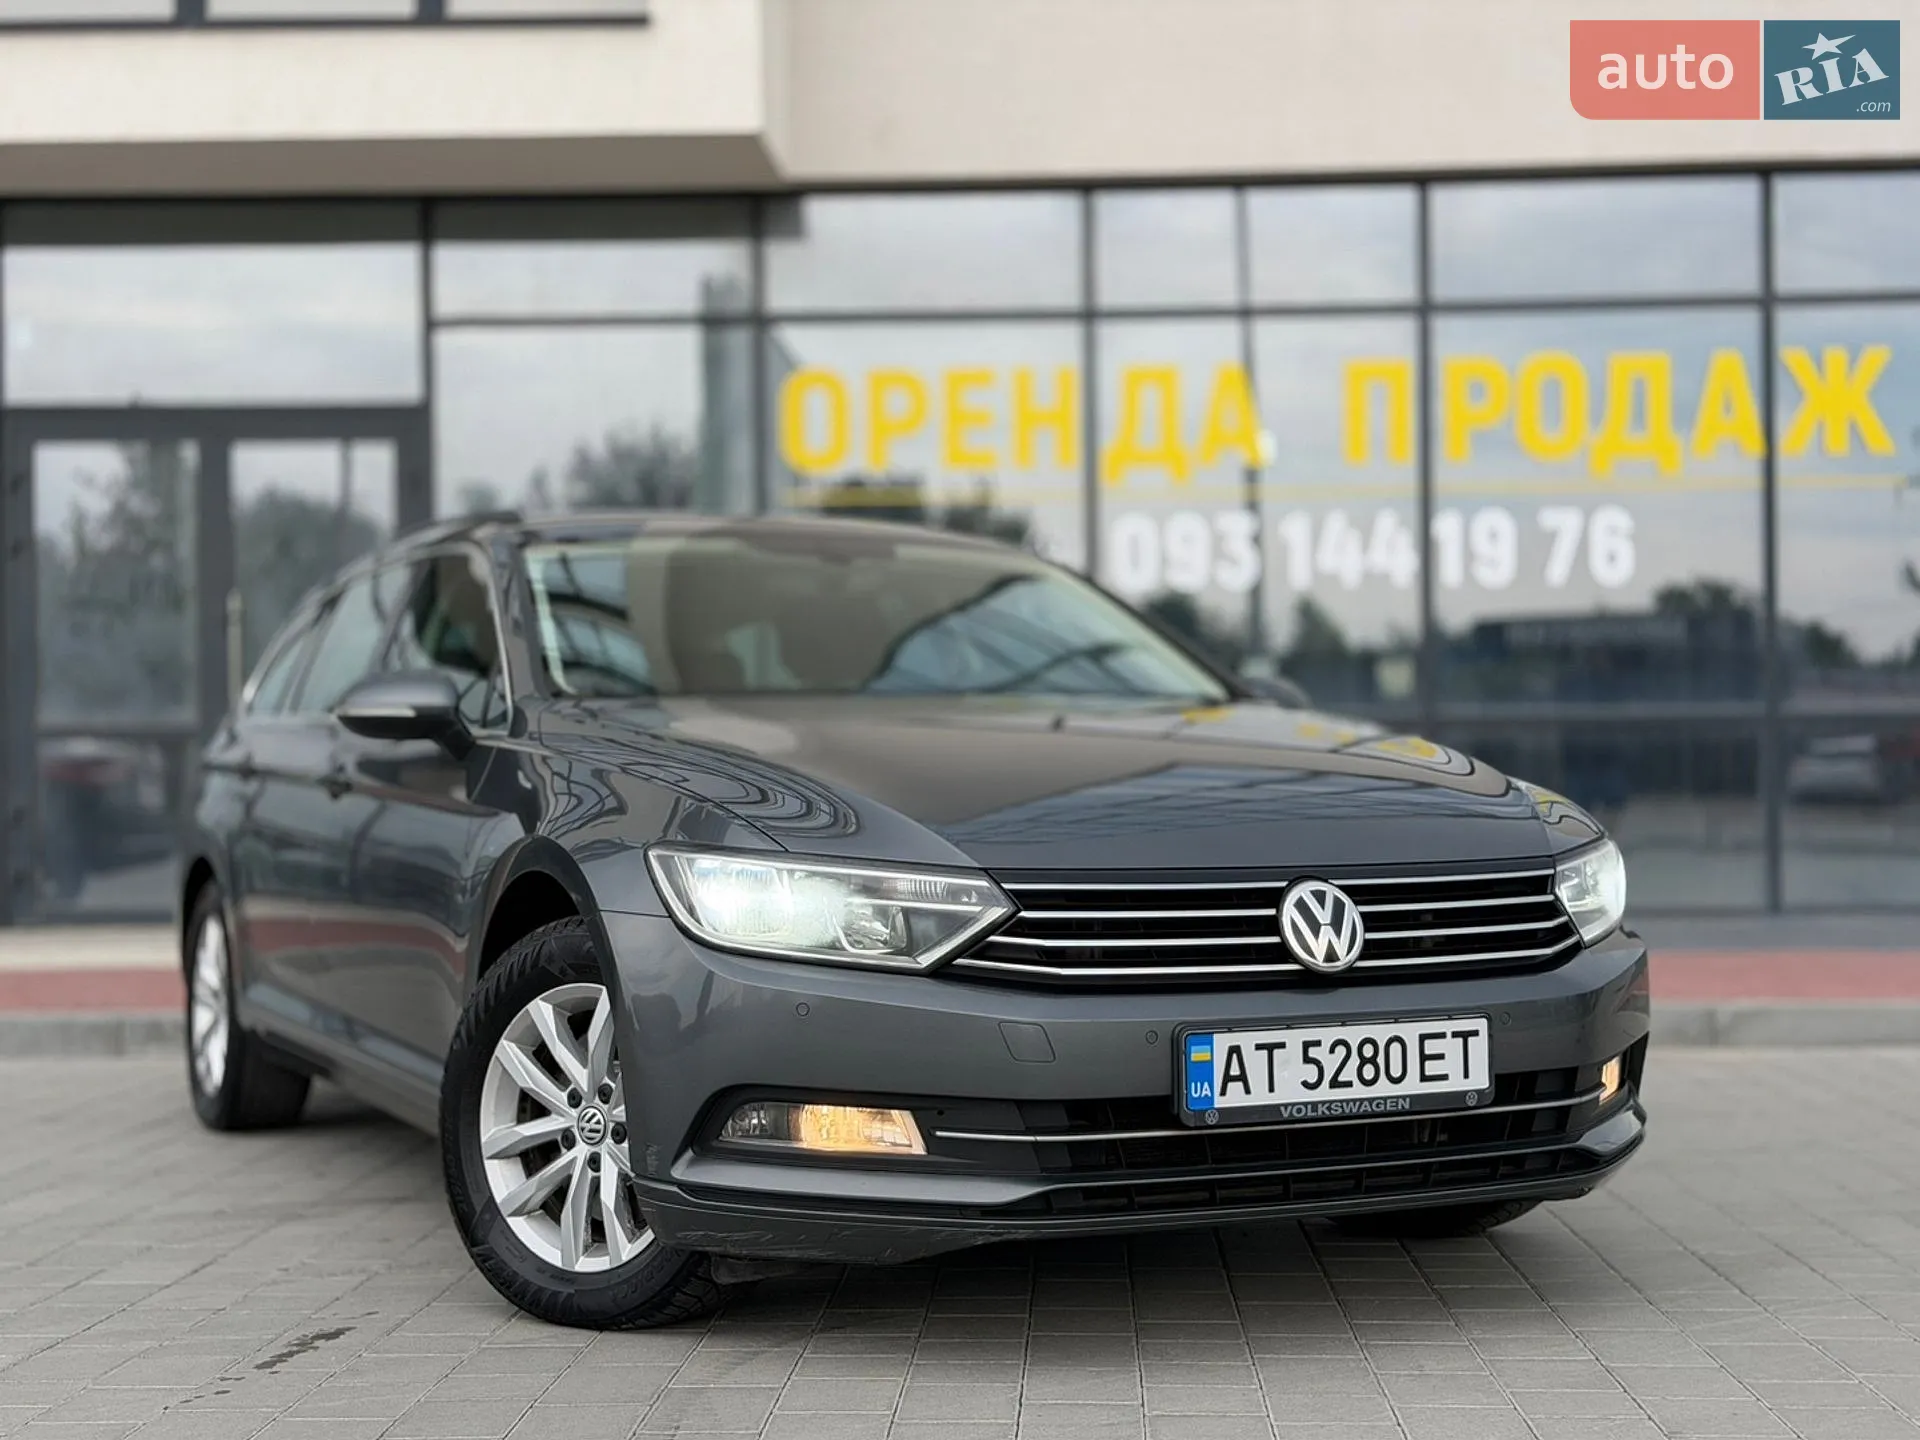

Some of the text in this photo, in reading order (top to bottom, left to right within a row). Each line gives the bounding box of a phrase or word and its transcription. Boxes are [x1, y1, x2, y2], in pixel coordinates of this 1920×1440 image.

[779, 347, 1895, 485] ОРЕНДА ПРОДАЖ
[1108, 503, 1636, 594] 093 144 19 76
[1190, 1081, 1212, 1098] UA
[1219, 1029, 1480, 1097] AT 5280 ET
[1280, 1098, 1411, 1118] VOLKSWAGEN
